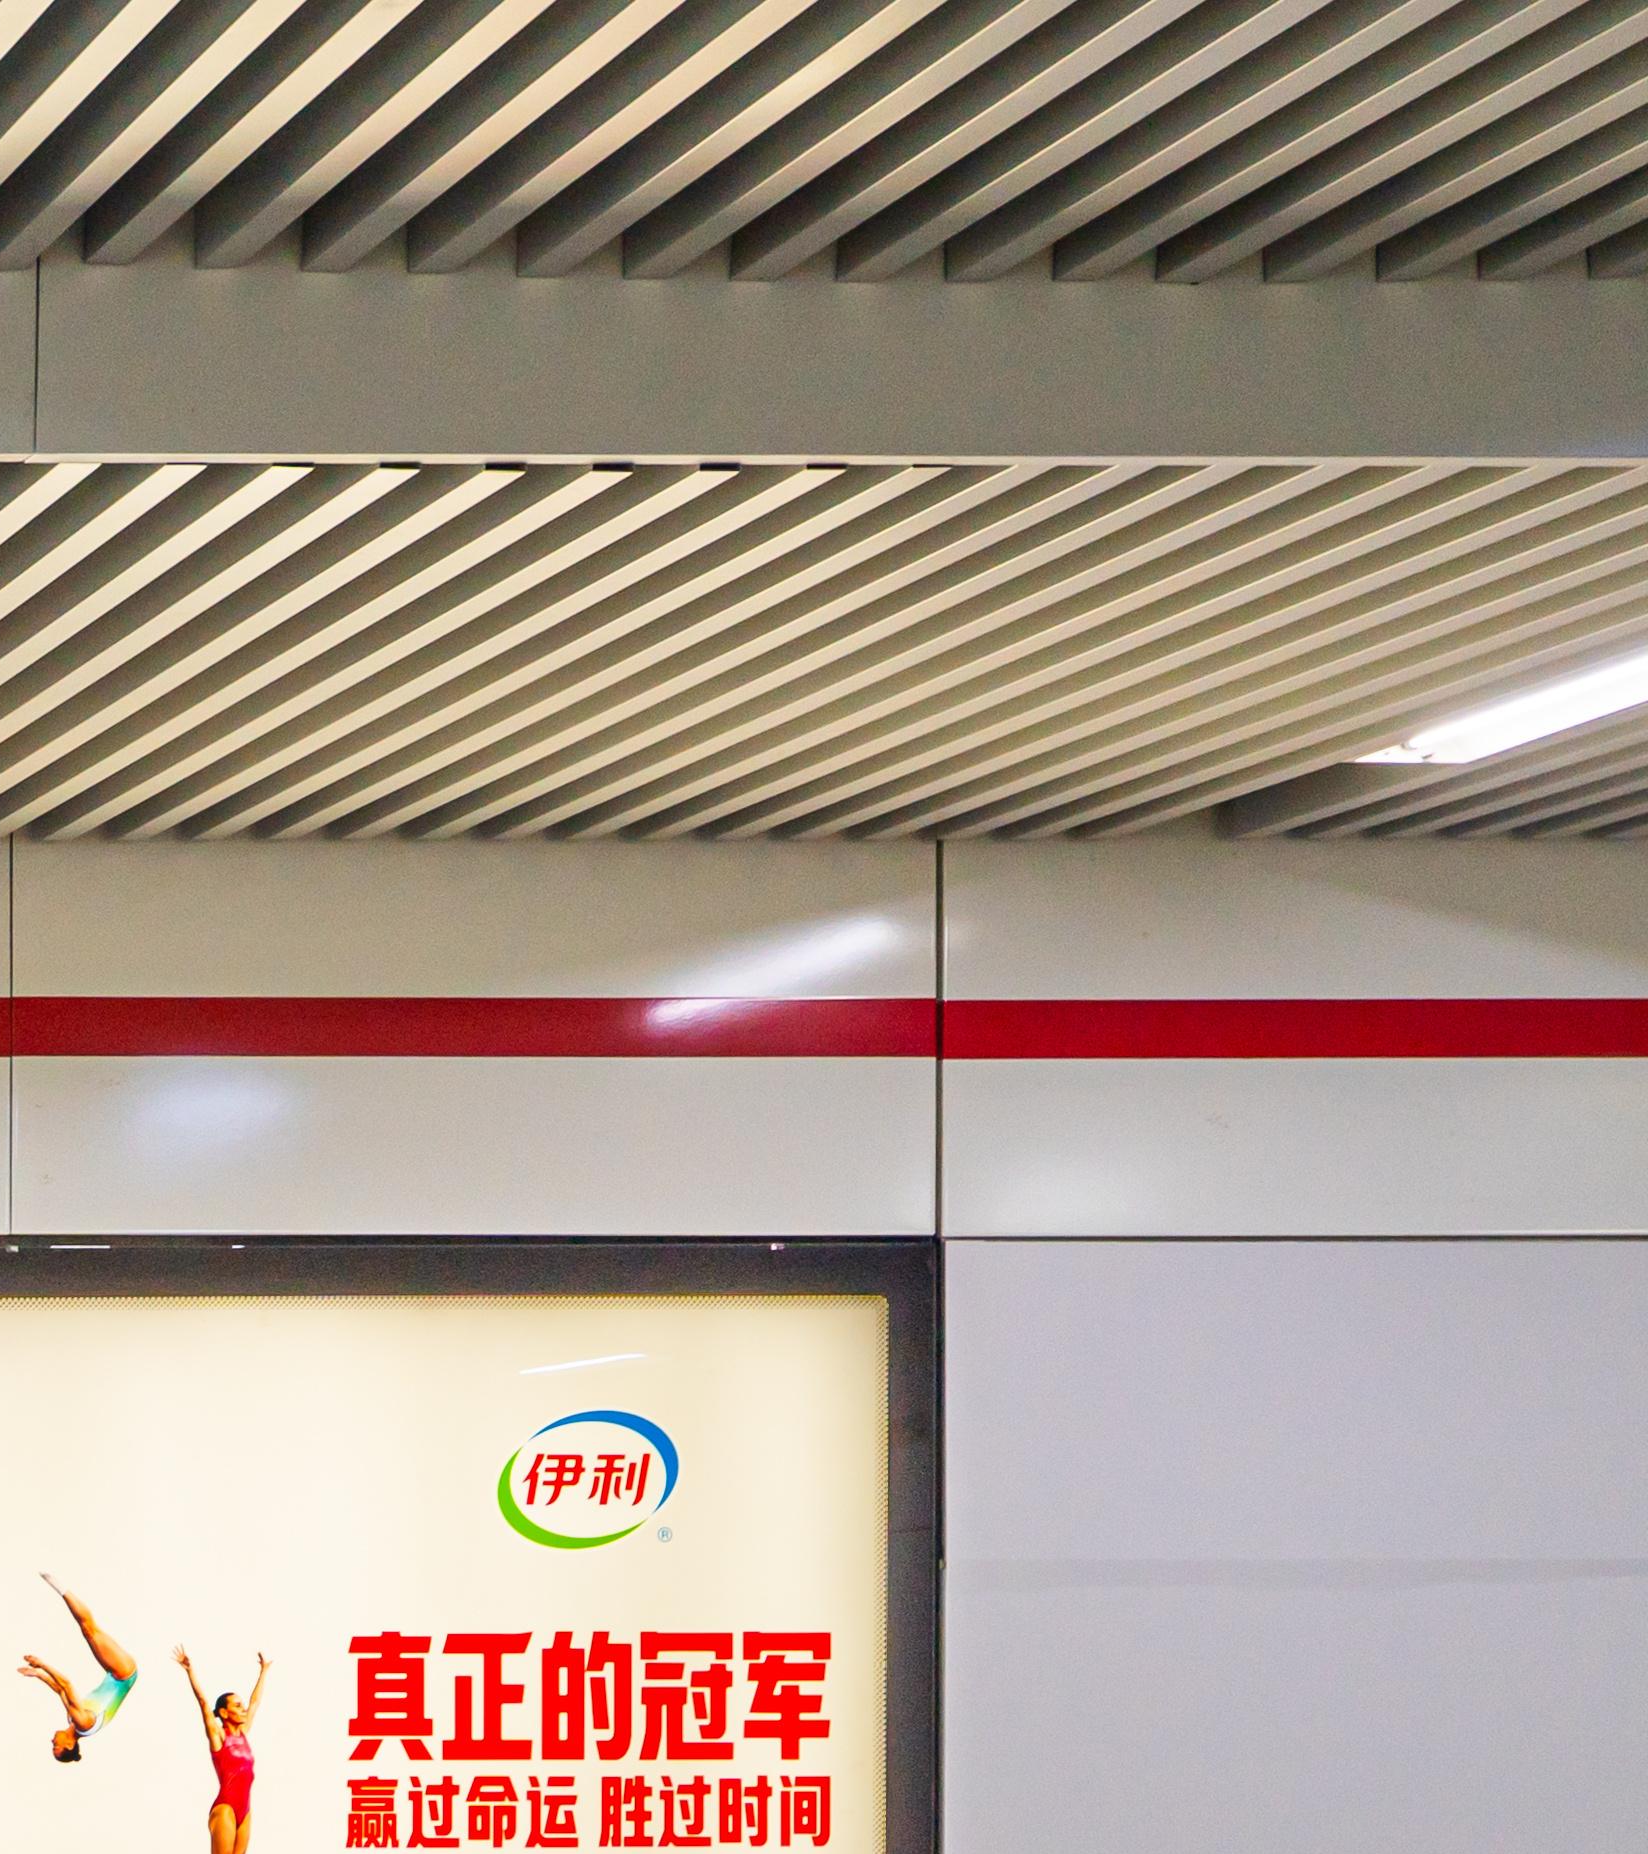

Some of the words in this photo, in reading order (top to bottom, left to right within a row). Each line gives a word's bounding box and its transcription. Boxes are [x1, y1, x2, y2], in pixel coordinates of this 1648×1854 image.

[523, 1453, 653, 1506] 伊利
[347, 1630, 833, 1762] 真正的冠军
[345, 1775, 579, 1850] 赢过命运
[598, 1775, 833, 1849] 胜过时间
